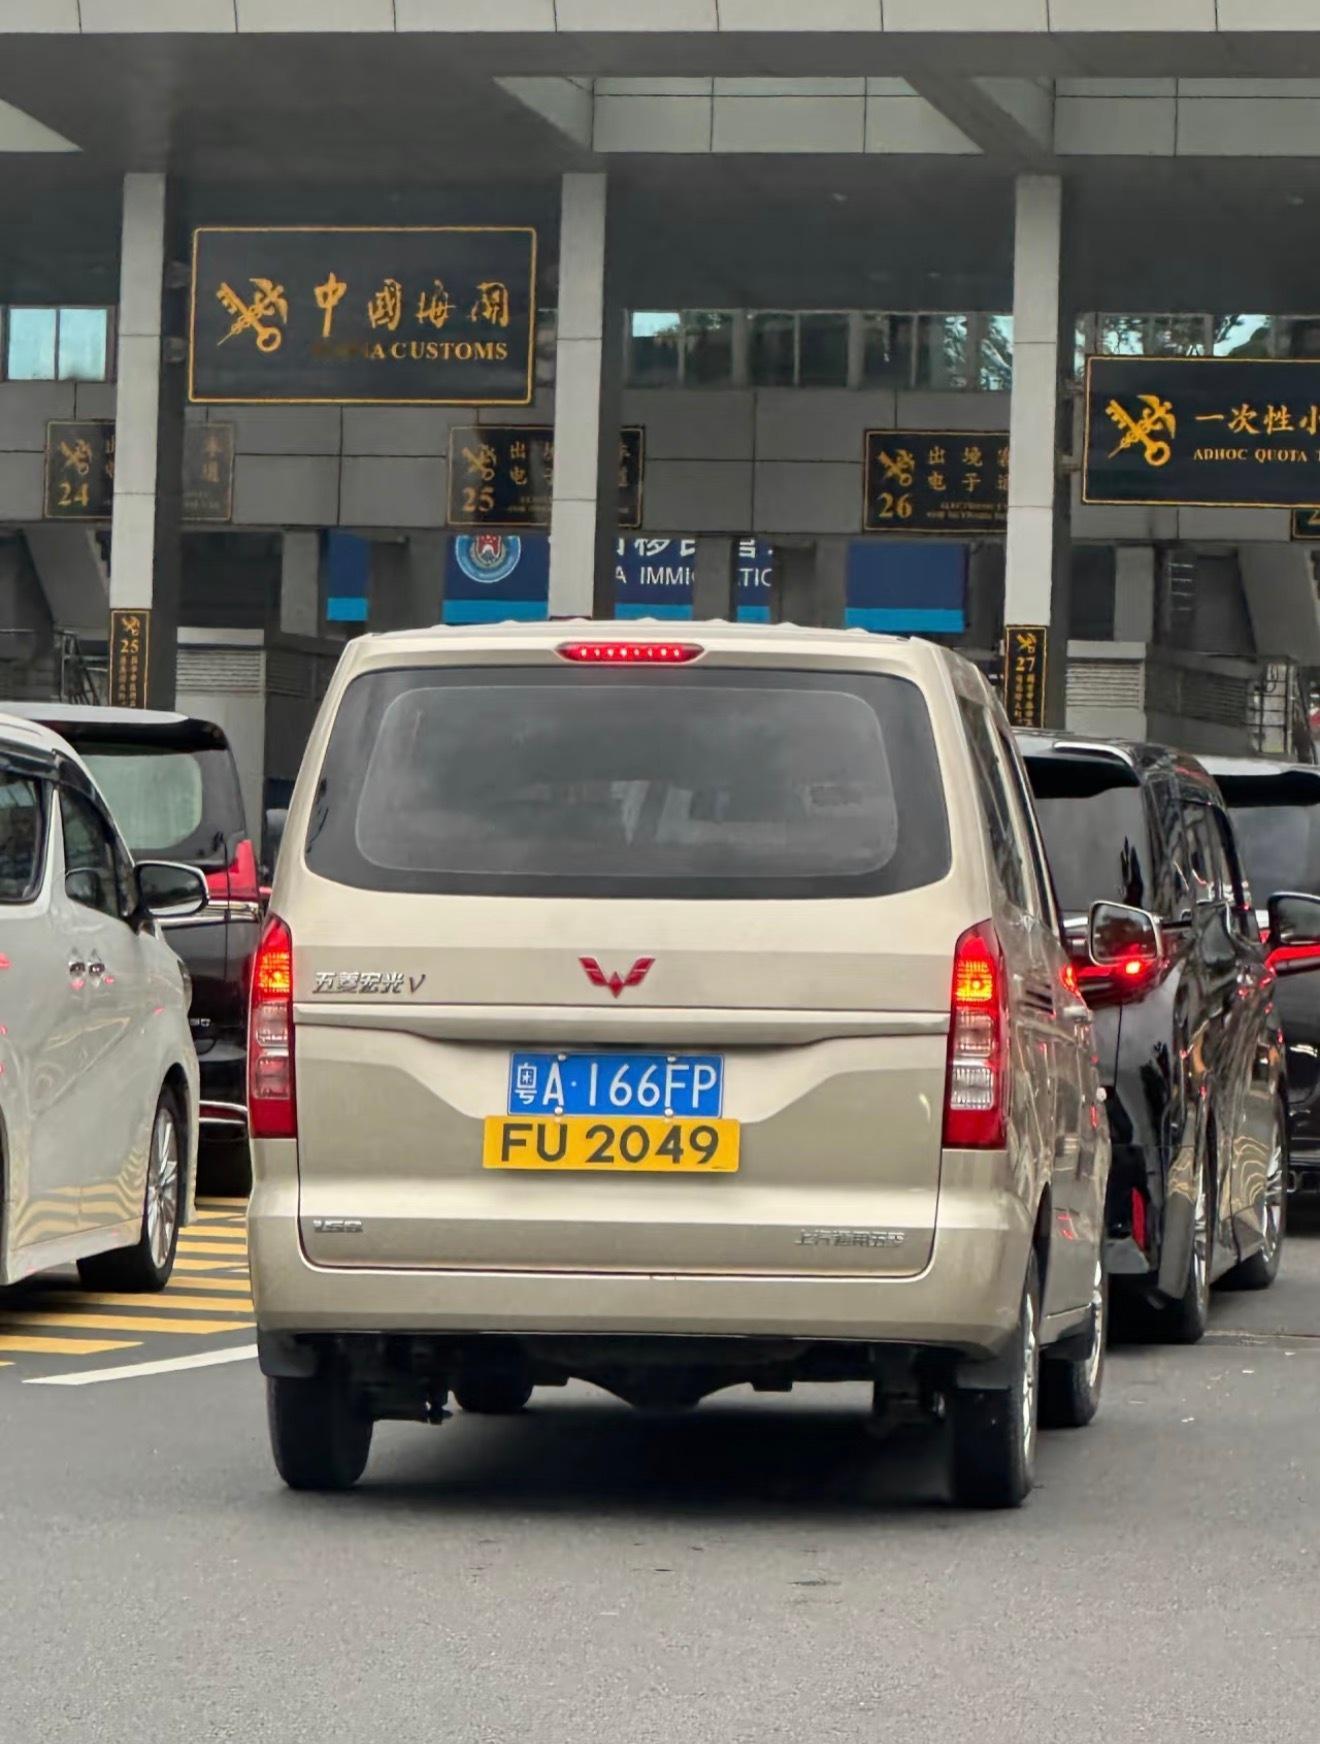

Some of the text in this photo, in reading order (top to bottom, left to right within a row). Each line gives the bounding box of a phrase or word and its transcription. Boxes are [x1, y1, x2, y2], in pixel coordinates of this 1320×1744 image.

[391, 341, 508, 360] CUSTOMS
[1194, 448, 1248, 461] ADHOC
[1255, 448, 1308, 463] QUOTA
[58, 482, 89, 507] 24
[462, 486, 494, 512] 25
[878, 492, 913, 518] 26
[121, 639, 139, 654] 25
[1015, 656, 1036, 672] 27
[501, 1122, 719, 1165] FU 2049
